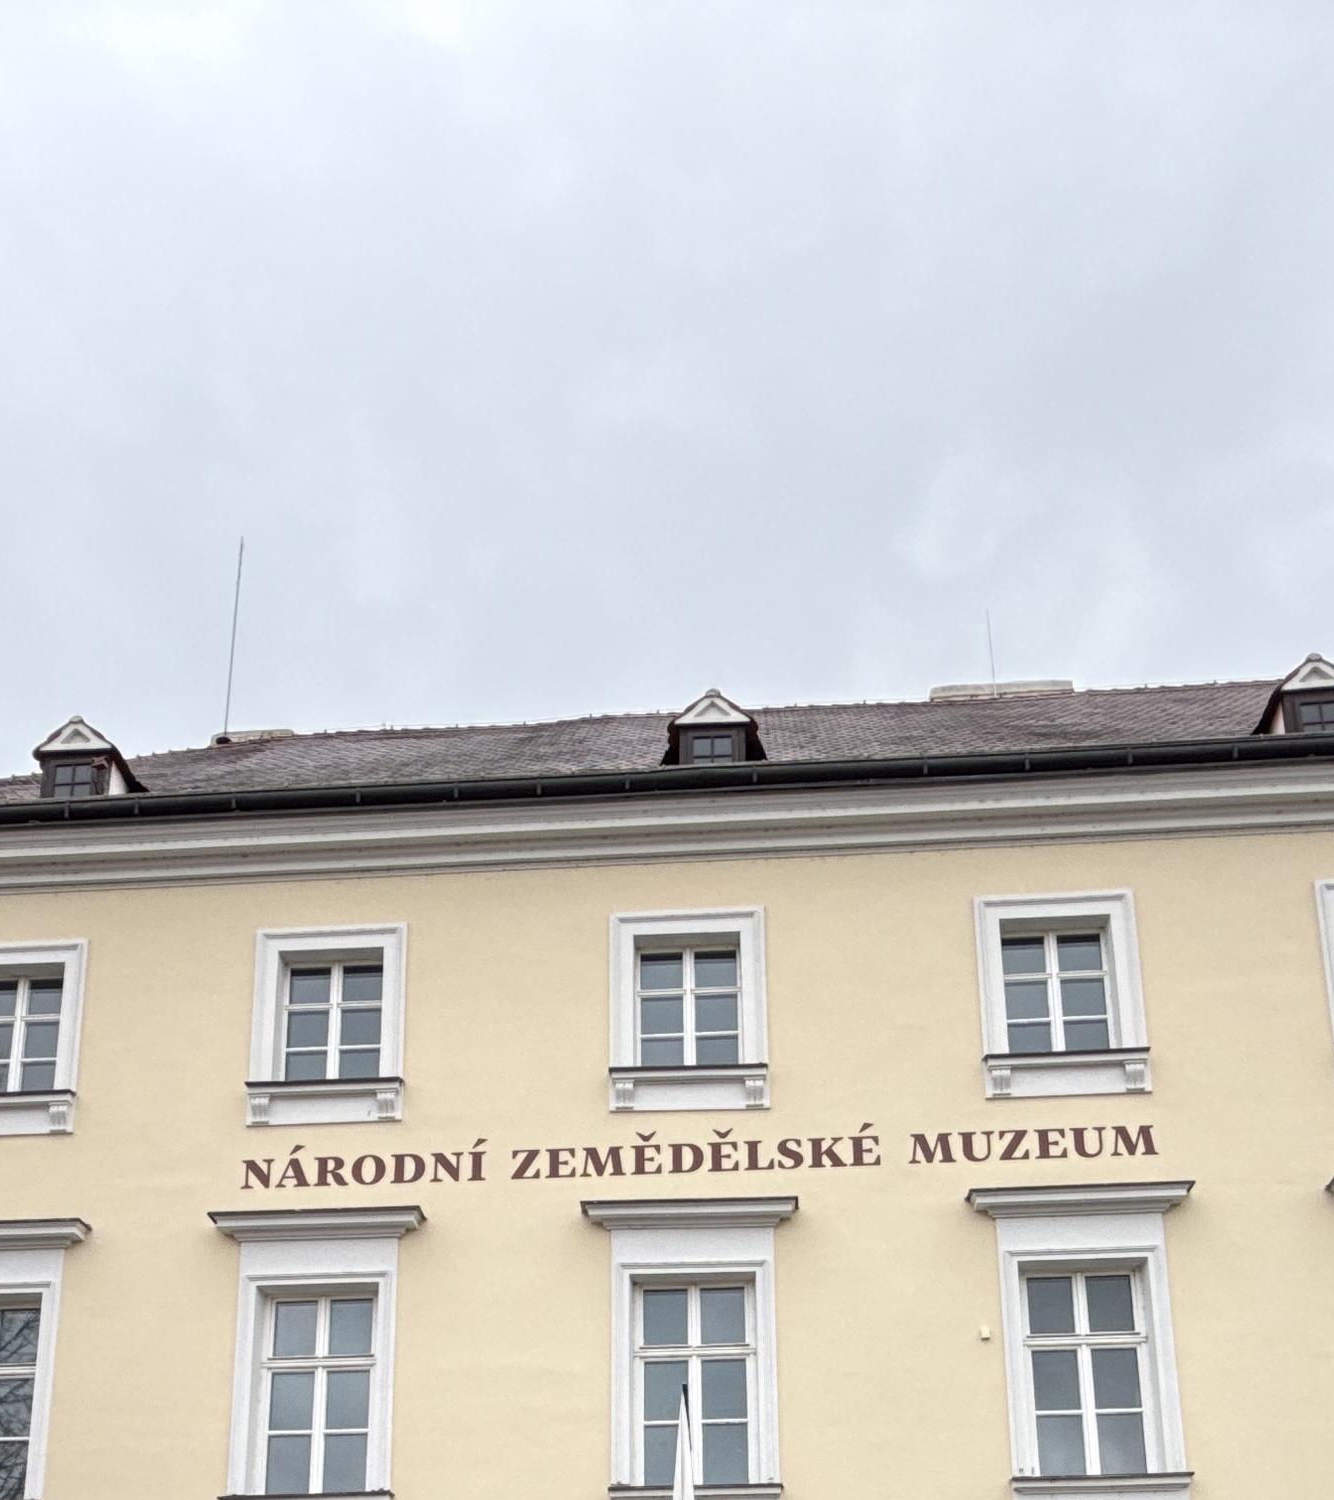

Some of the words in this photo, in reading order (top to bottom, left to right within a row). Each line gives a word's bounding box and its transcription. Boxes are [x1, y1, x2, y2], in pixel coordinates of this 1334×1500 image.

[240, 1138, 489, 1189] NÁRODNÍ
[511, 1122, 881, 1180] ZEMĚDĚLSKÉ
[908, 1124, 1159, 1165] MUZEUM
